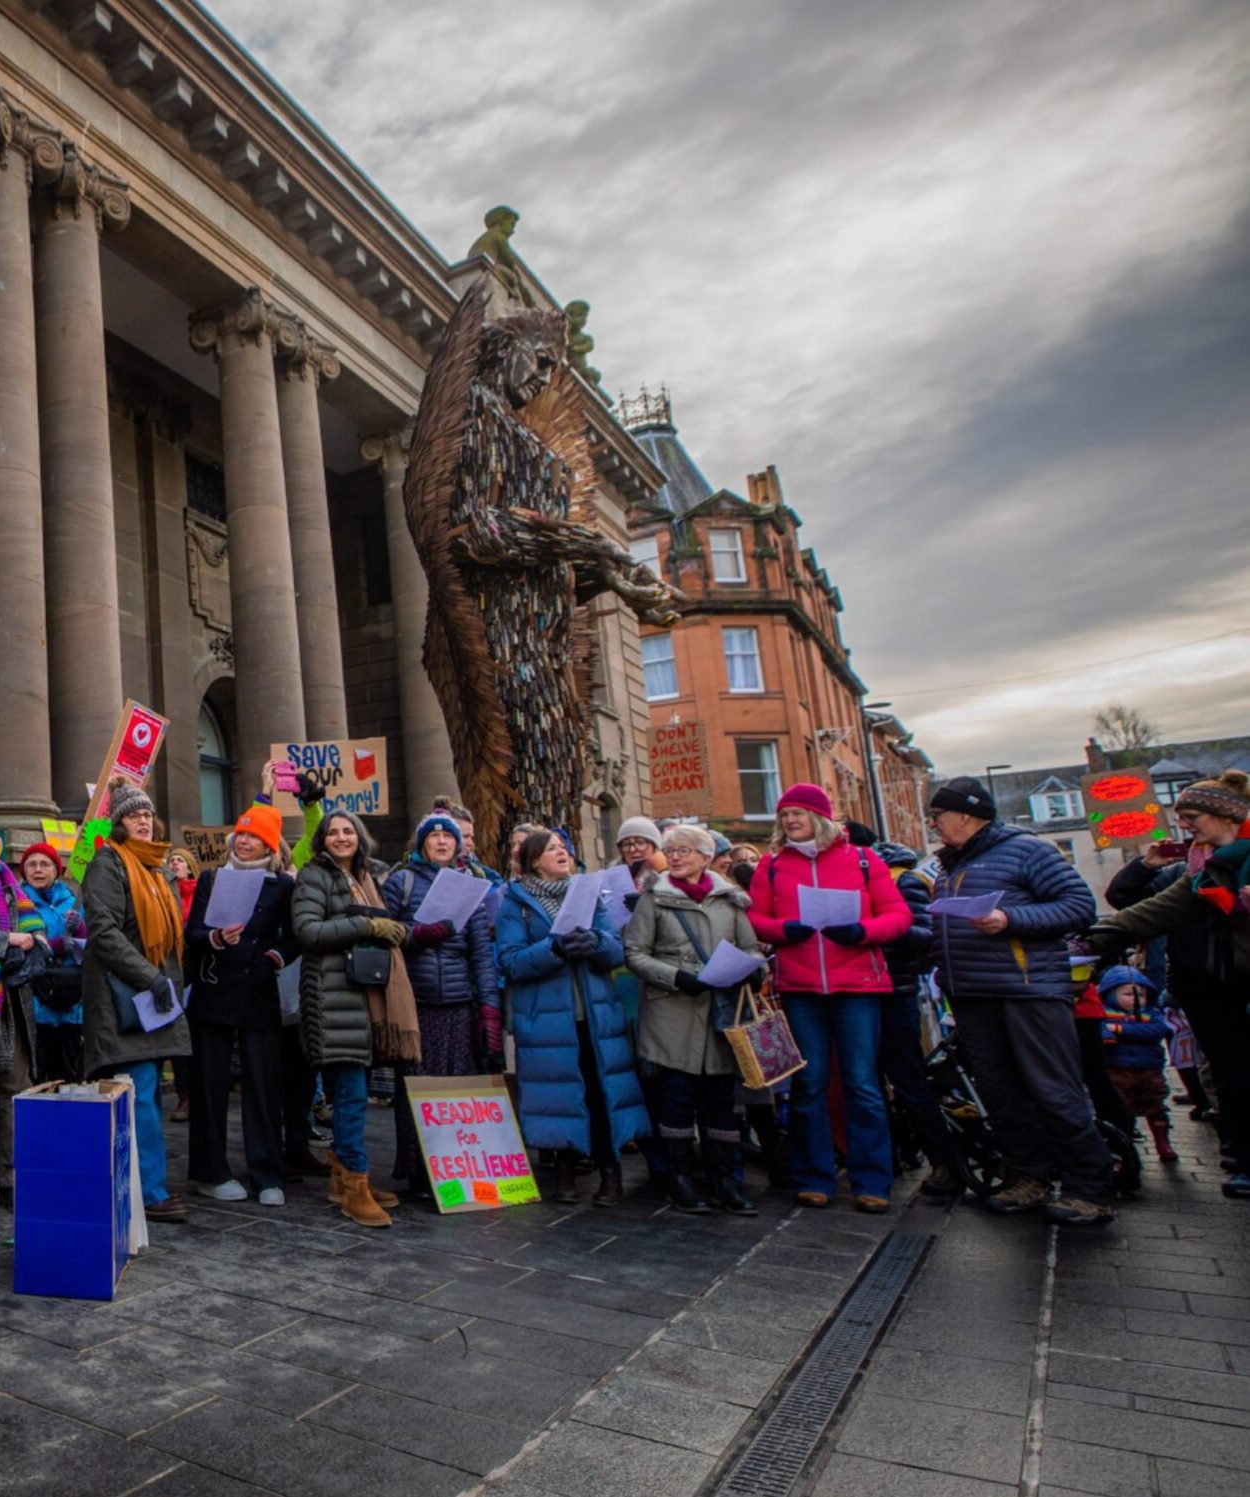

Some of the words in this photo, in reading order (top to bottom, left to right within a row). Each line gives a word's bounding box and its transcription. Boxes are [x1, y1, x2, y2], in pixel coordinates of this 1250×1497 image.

[656, 721, 698, 743] DON'T
[650, 739, 700, 759] SHELVE
[652, 756, 701, 778] COMRIE
[653, 774, 705, 794] LIBRARY
